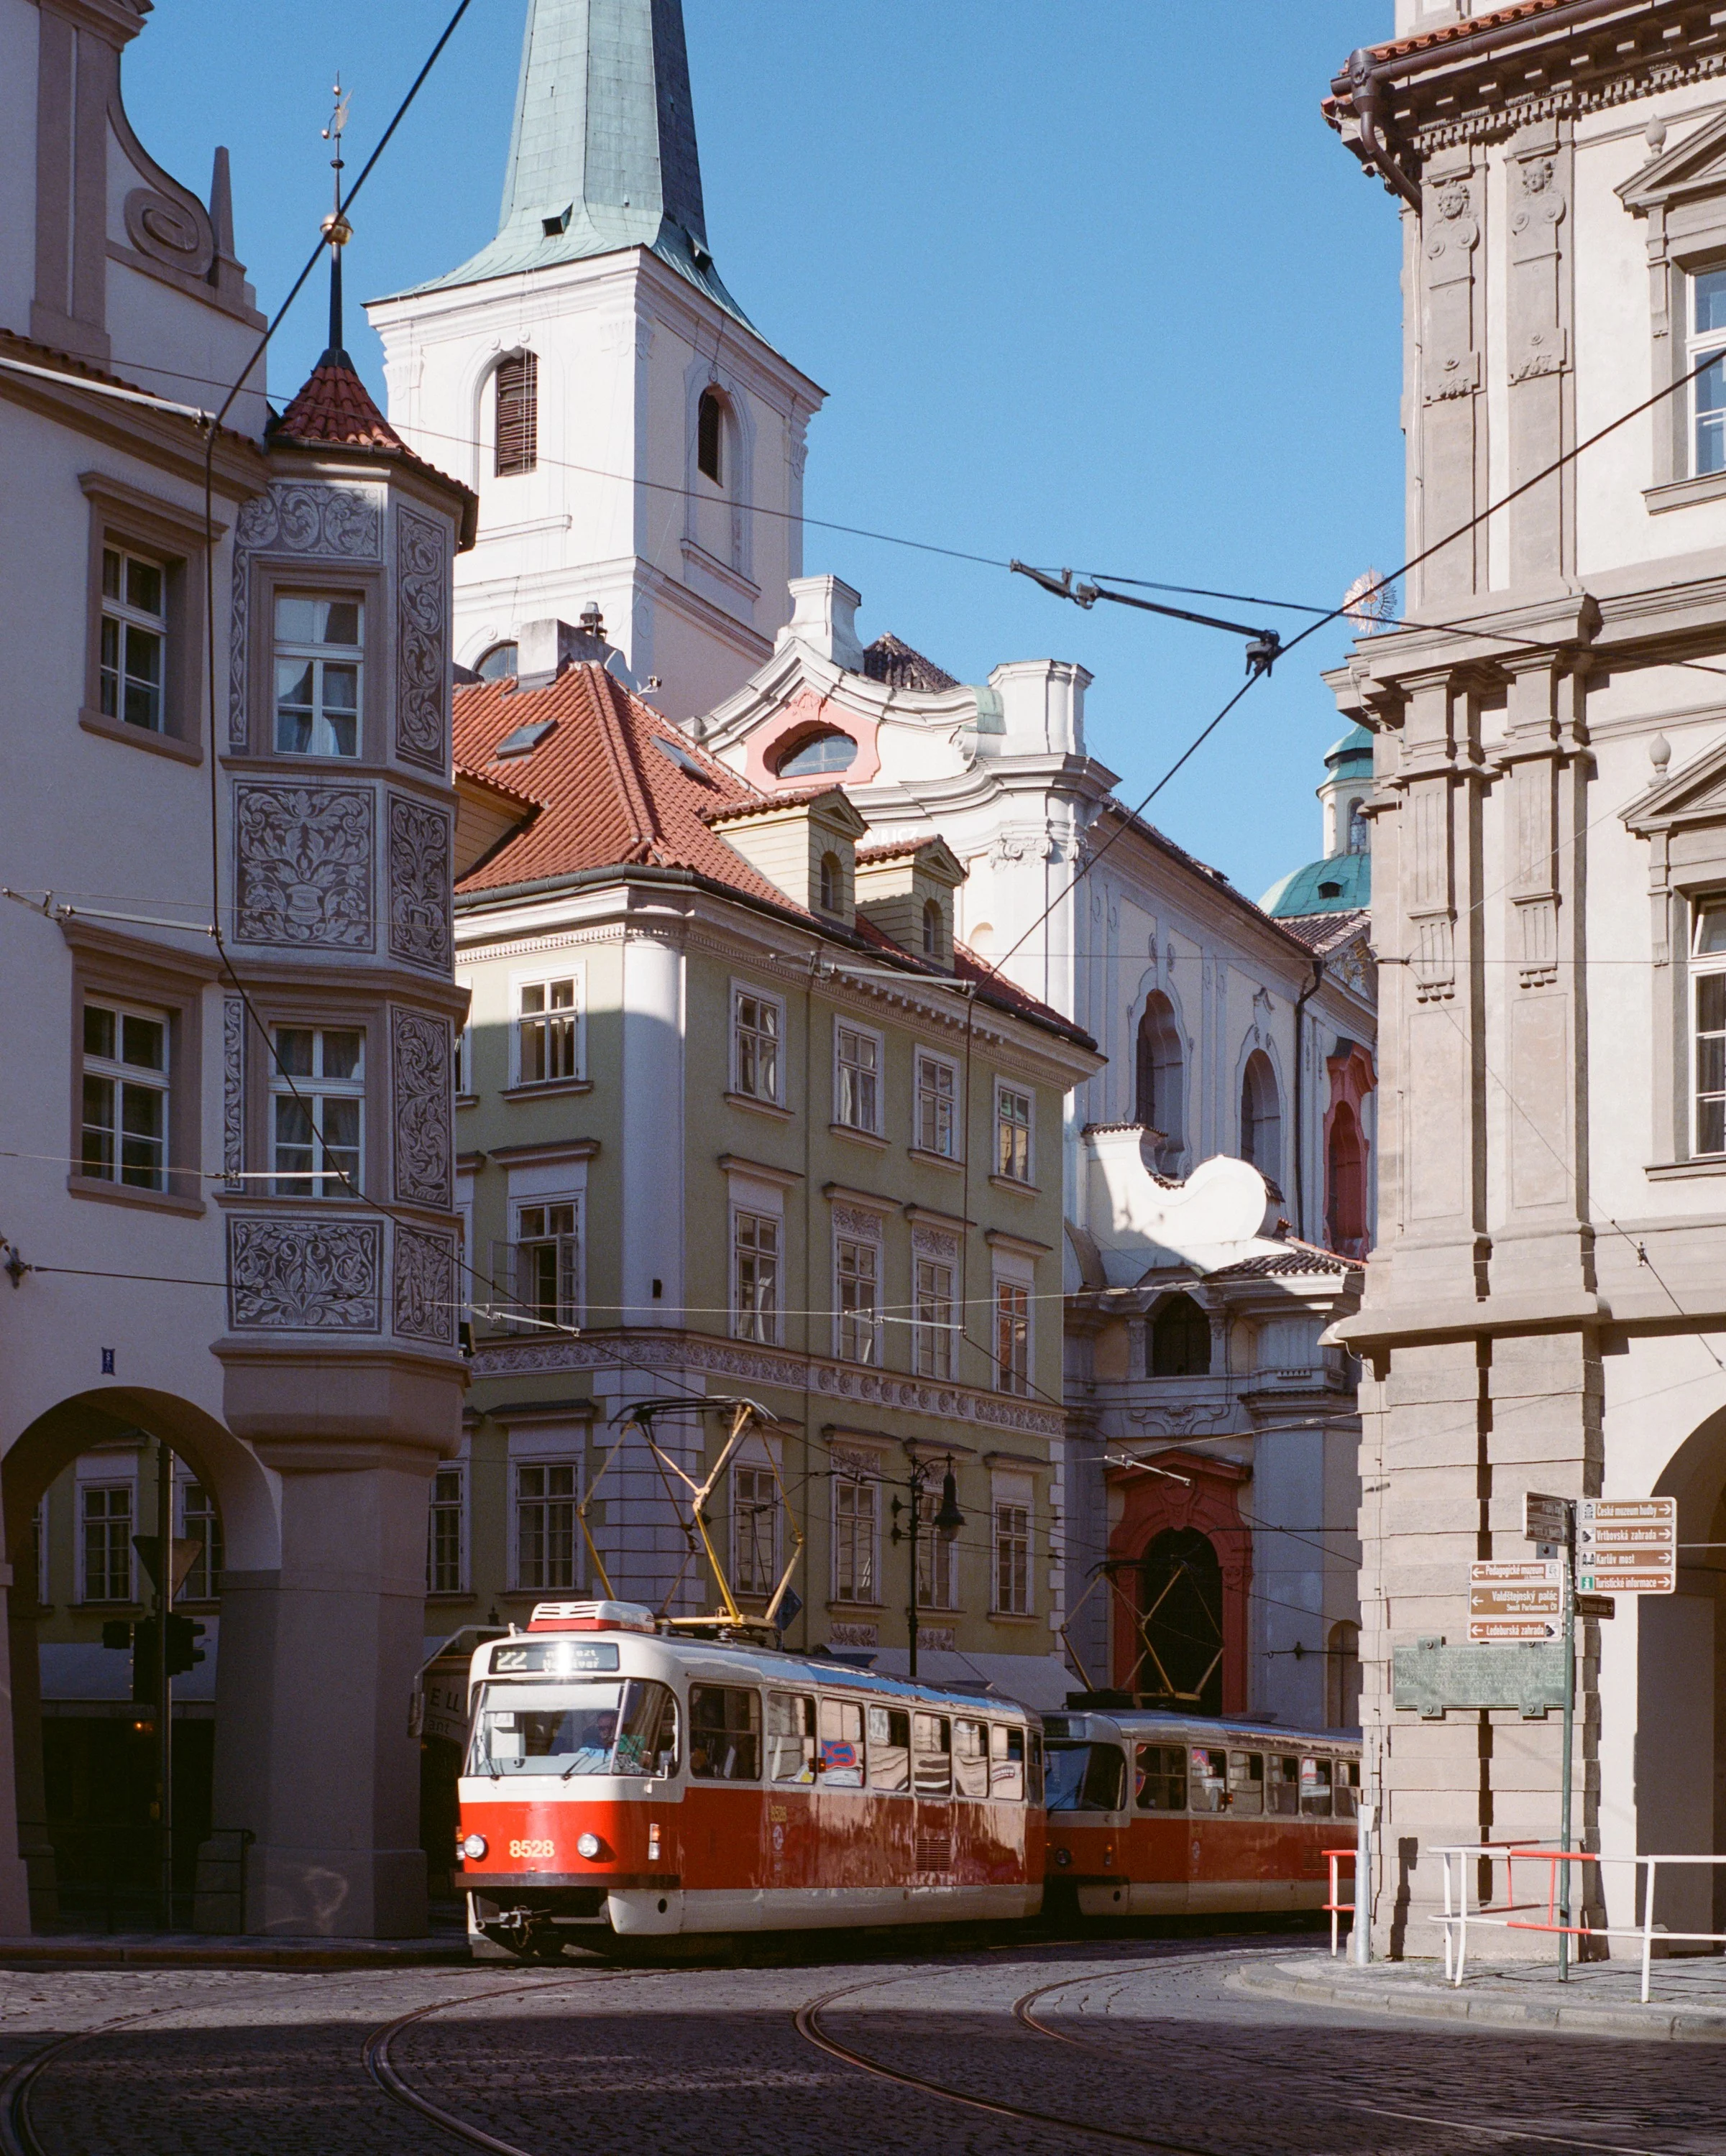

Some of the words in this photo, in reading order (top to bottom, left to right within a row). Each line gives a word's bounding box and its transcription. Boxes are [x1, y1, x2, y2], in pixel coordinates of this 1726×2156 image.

[1597, 1503, 1614, 1516] České
[1615, 1507, 1638, 1516] muzeum
[1640, 1504, 1657, 1518] hudby
[1597, 1529, 1628, 1541] Vrtbovská
[1630, 1529, 1656, 1540] zahrada
[1597, 1553, 1617, 1565] Karlův
[1619, 1554, 1635, 1564] most
[1485, 1565, 1520, 1577] Pedagogické
[1595, 1577, 1624, 1588] Turistické
[1625, 1577, 1656, 1588] informace
[1492, 1590, 1536, 1603] Valdštejnský
[1538, 1590, 1557, 1603] palác
[1486, 1624, 1519, 1636] Ledeburská
[1520, 1624, 1544, 1636] zahrada
[496, 1651, 527, 1671] 22
[509, 1840, 555, 1858] 8528
